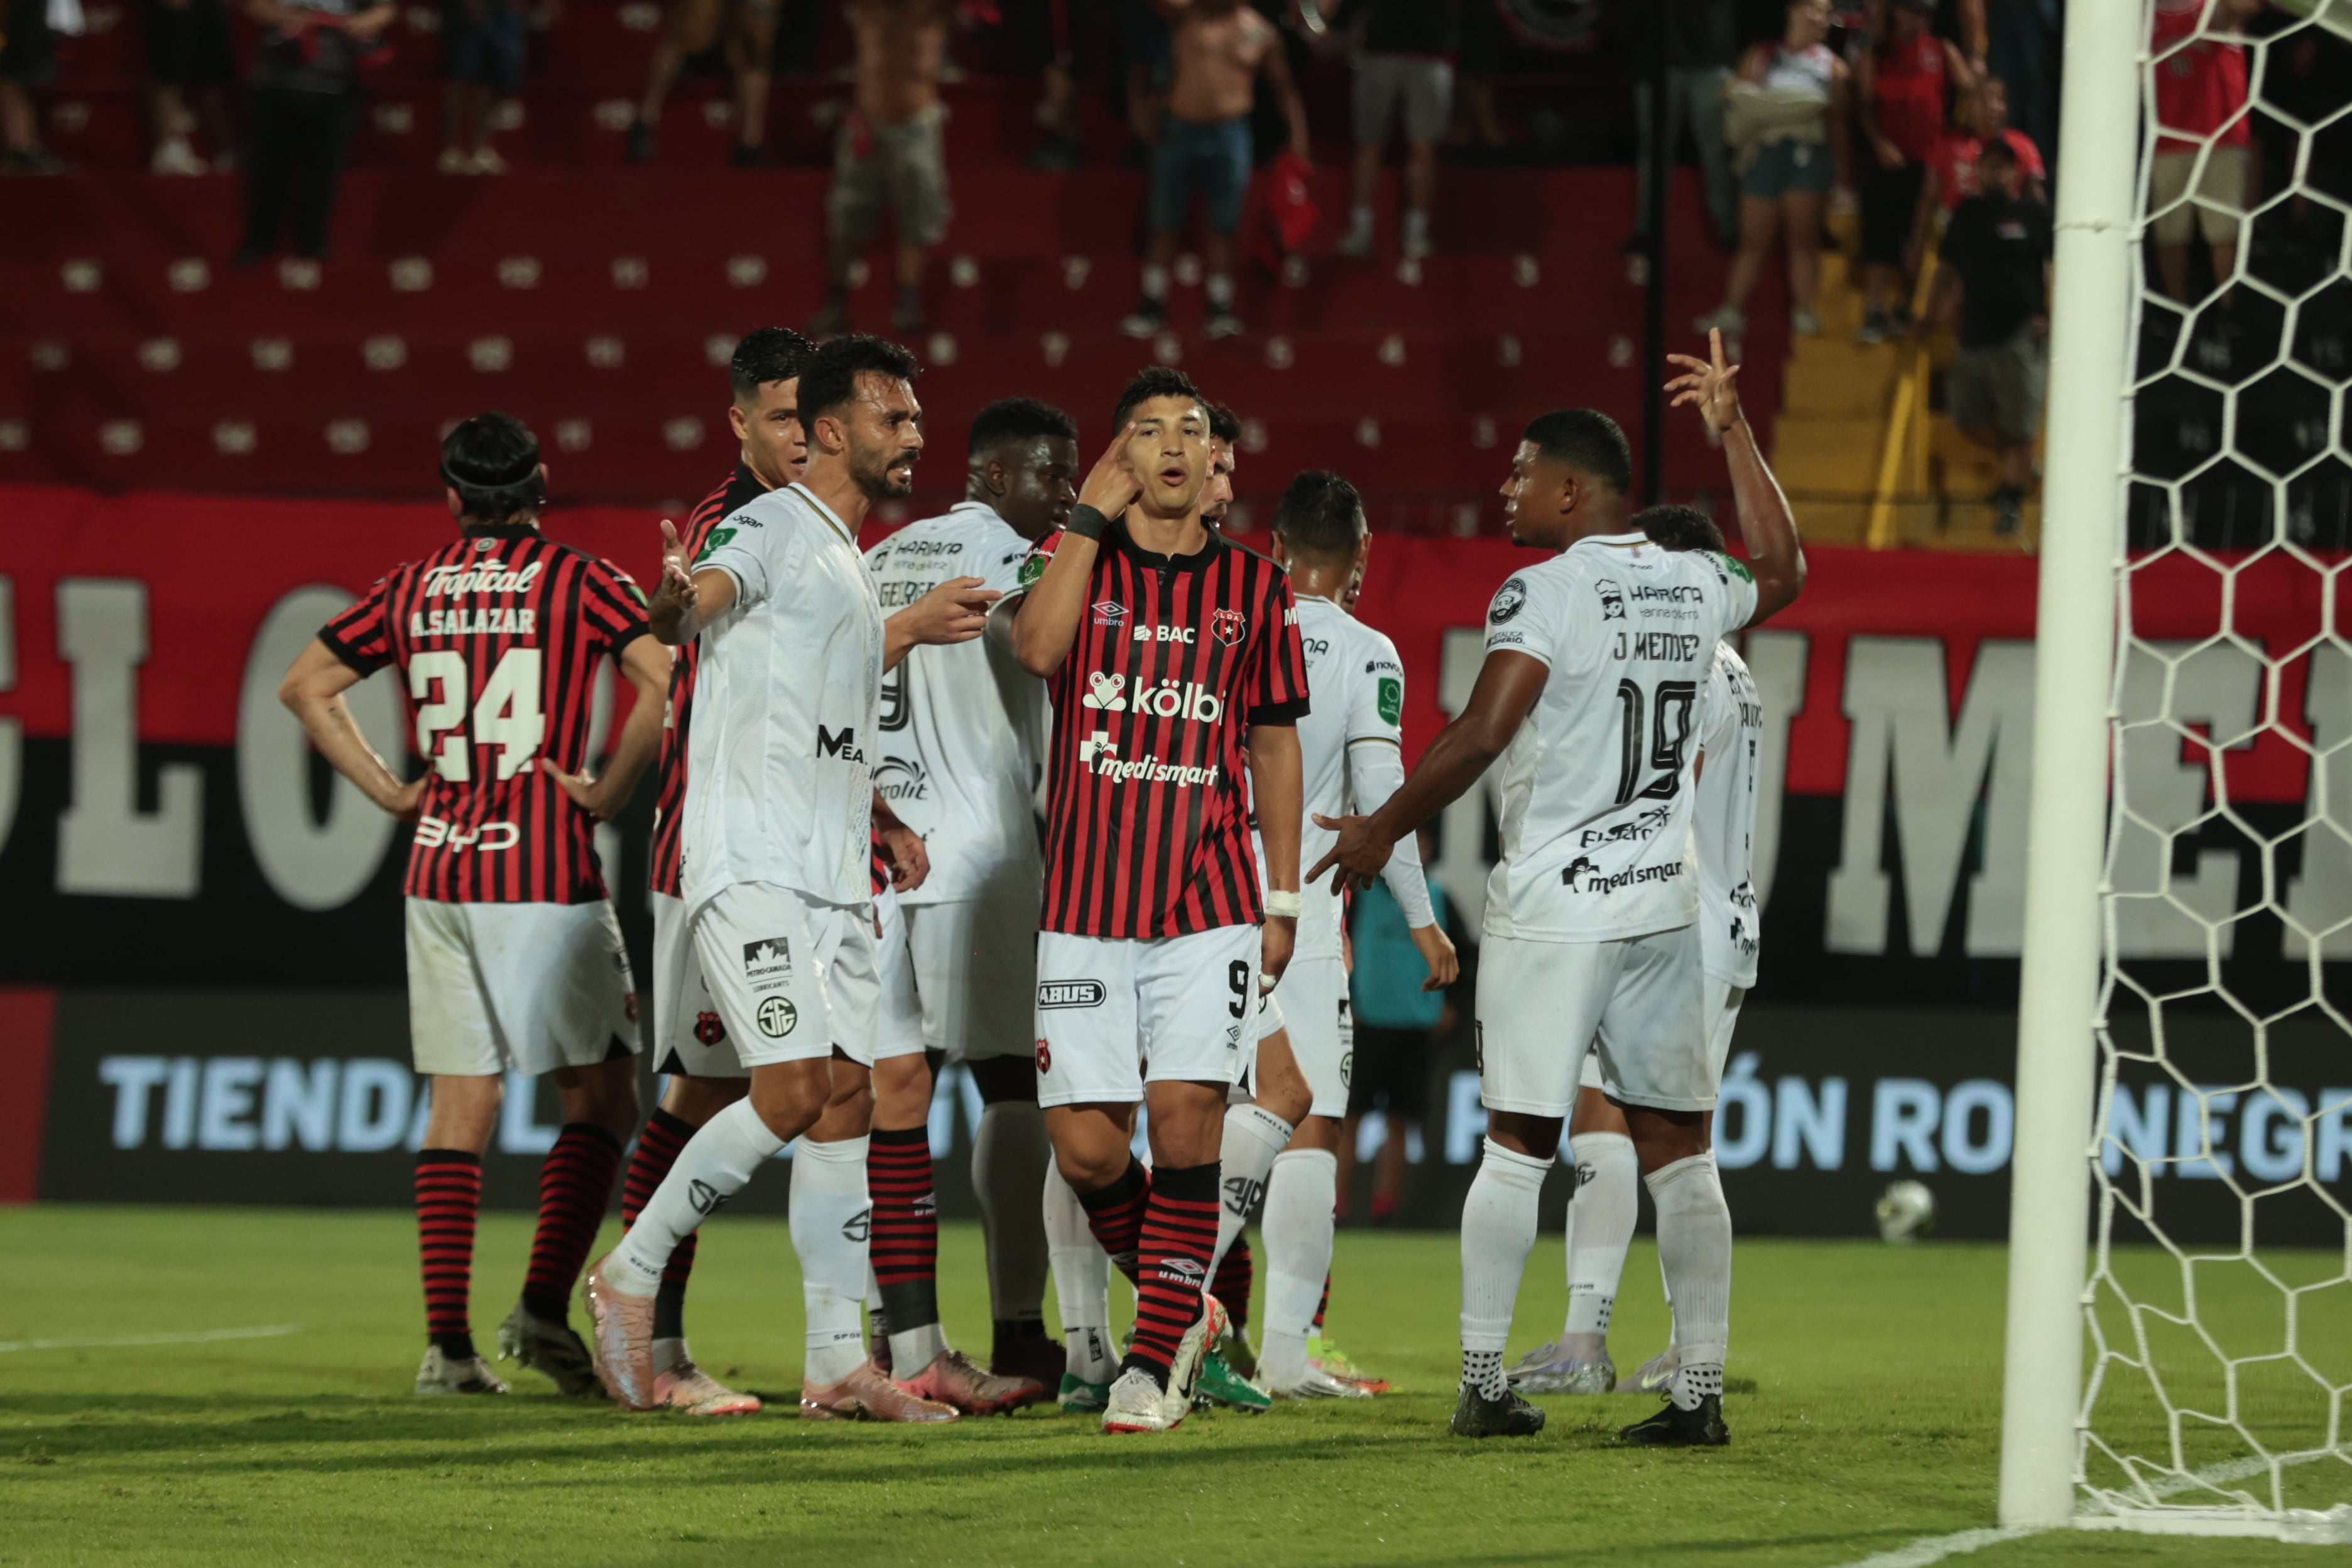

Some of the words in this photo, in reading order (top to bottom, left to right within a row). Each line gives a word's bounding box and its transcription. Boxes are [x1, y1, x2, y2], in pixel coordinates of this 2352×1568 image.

[423, 558, 543, 601] Tropical
[410, 608, 536, 638] A.SALAZAR
[1094, 618, 1124, 628] umbro
[1157, 625, 1195, 644] BAC
[1220, 612, 1239, 622] LDA
[408, 648, 545, 782] 24
[1131, 676, 1227, 726] kölbi
[1614, 678, 1697, 805] 19
[1098, 754, 1219, 788] medismart
[413, 816, 520, 852] BYD
[1588, 861, 1682, 895] medismar
[1039, 985, 1095, 1004] ABUS
[1229, 959, 1250, 1020] 9
[99, 1055, 432, 1153] TIEND
